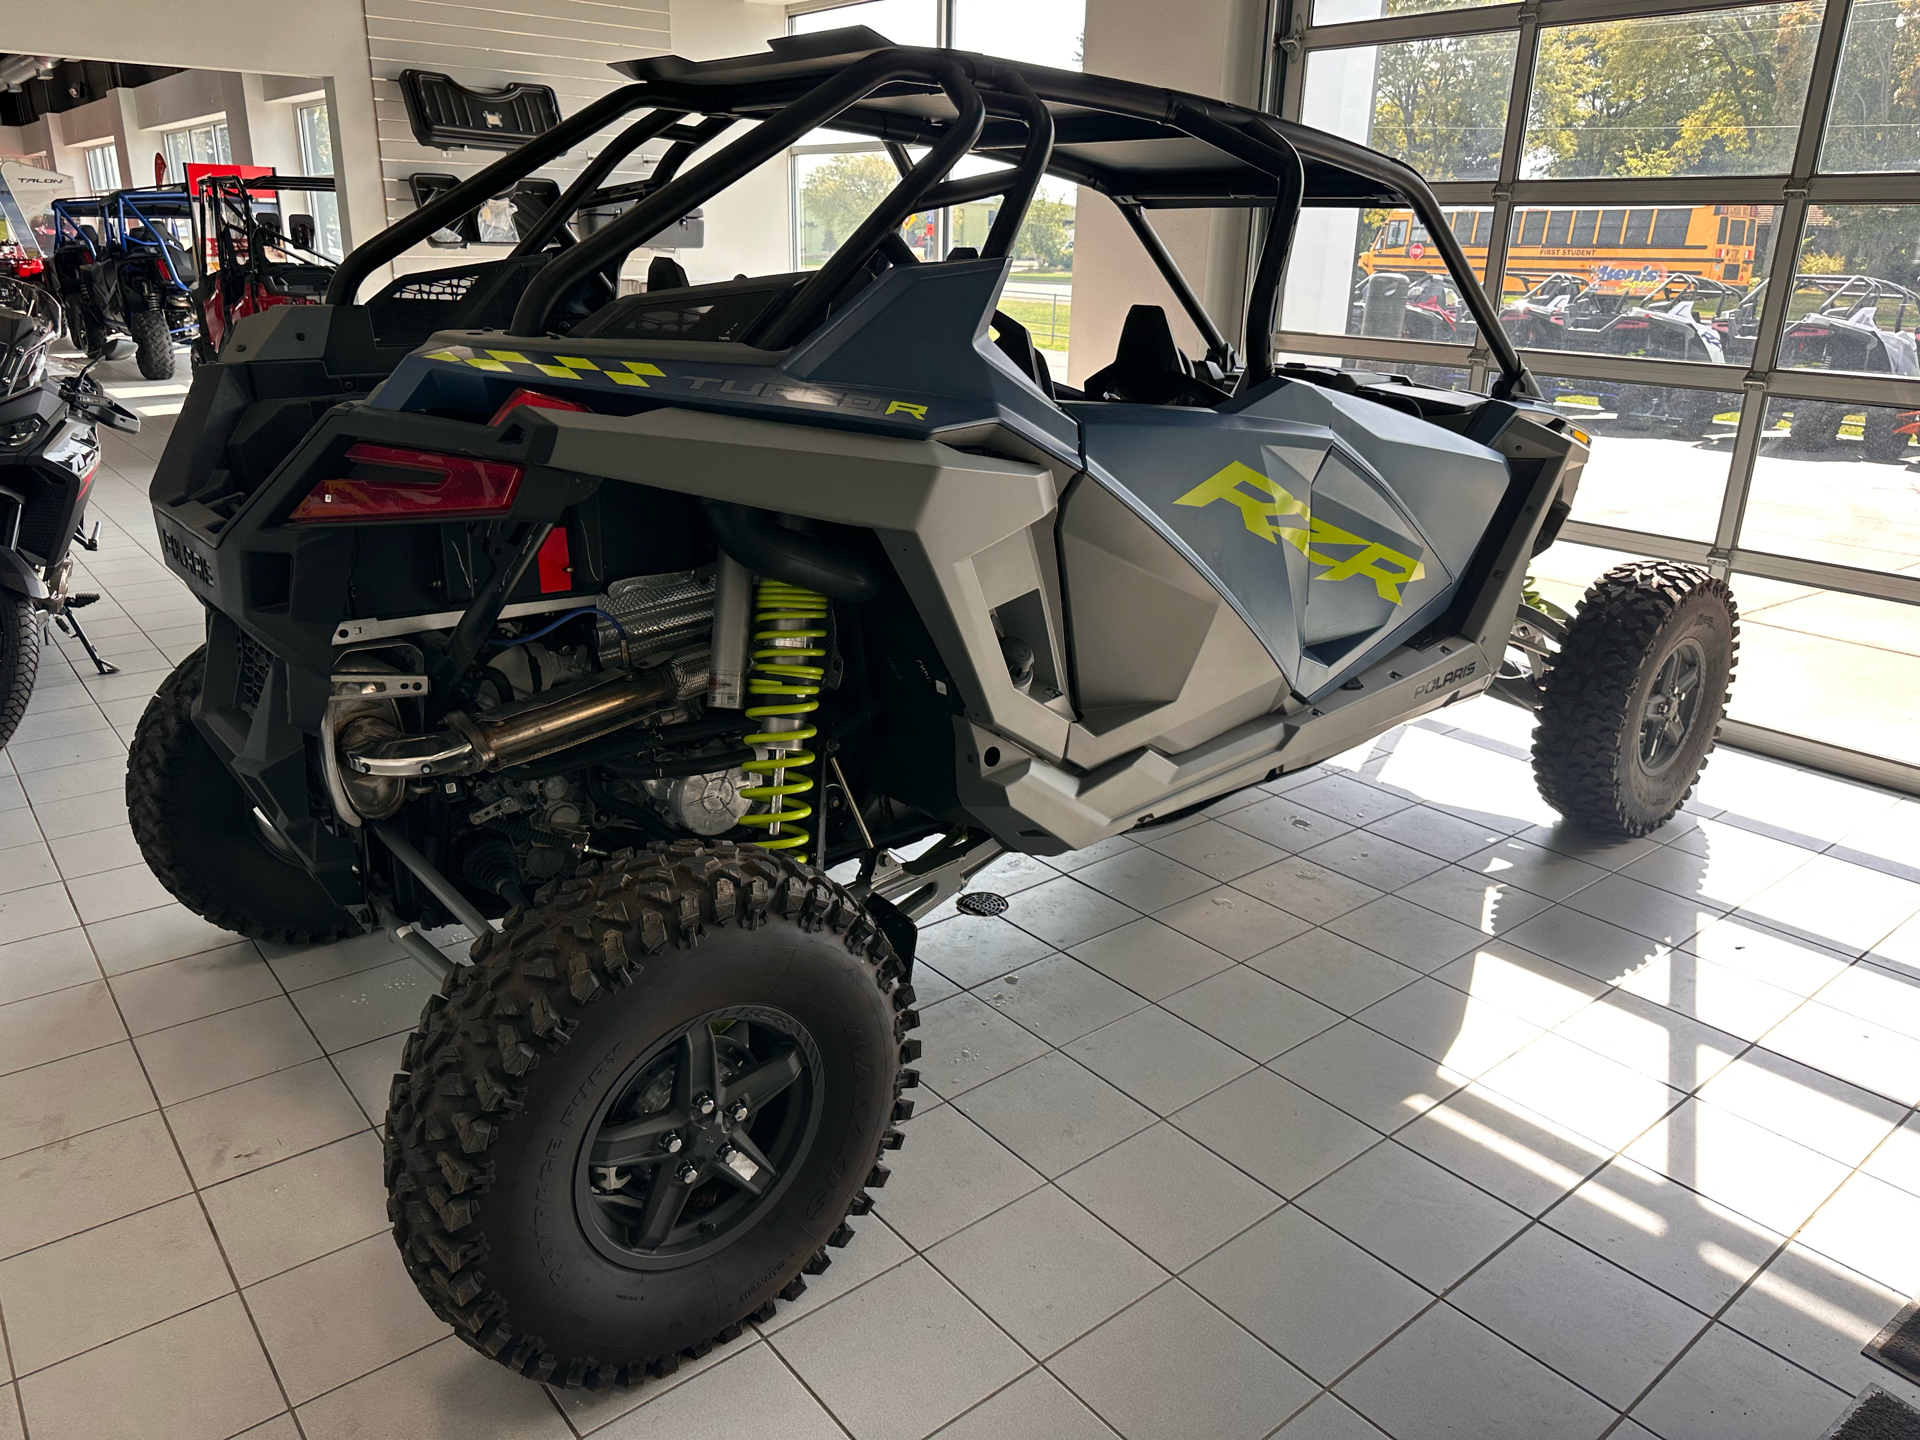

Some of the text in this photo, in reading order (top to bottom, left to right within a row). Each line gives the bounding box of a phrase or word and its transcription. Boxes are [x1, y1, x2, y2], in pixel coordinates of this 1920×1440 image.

[1615, 276, 1660, 294] Sports
[162, 528, 215, 588] POLARIS
[1172, 460, 1426, 607] RZR
[1413, 660, 1477, 700] POLARIS
